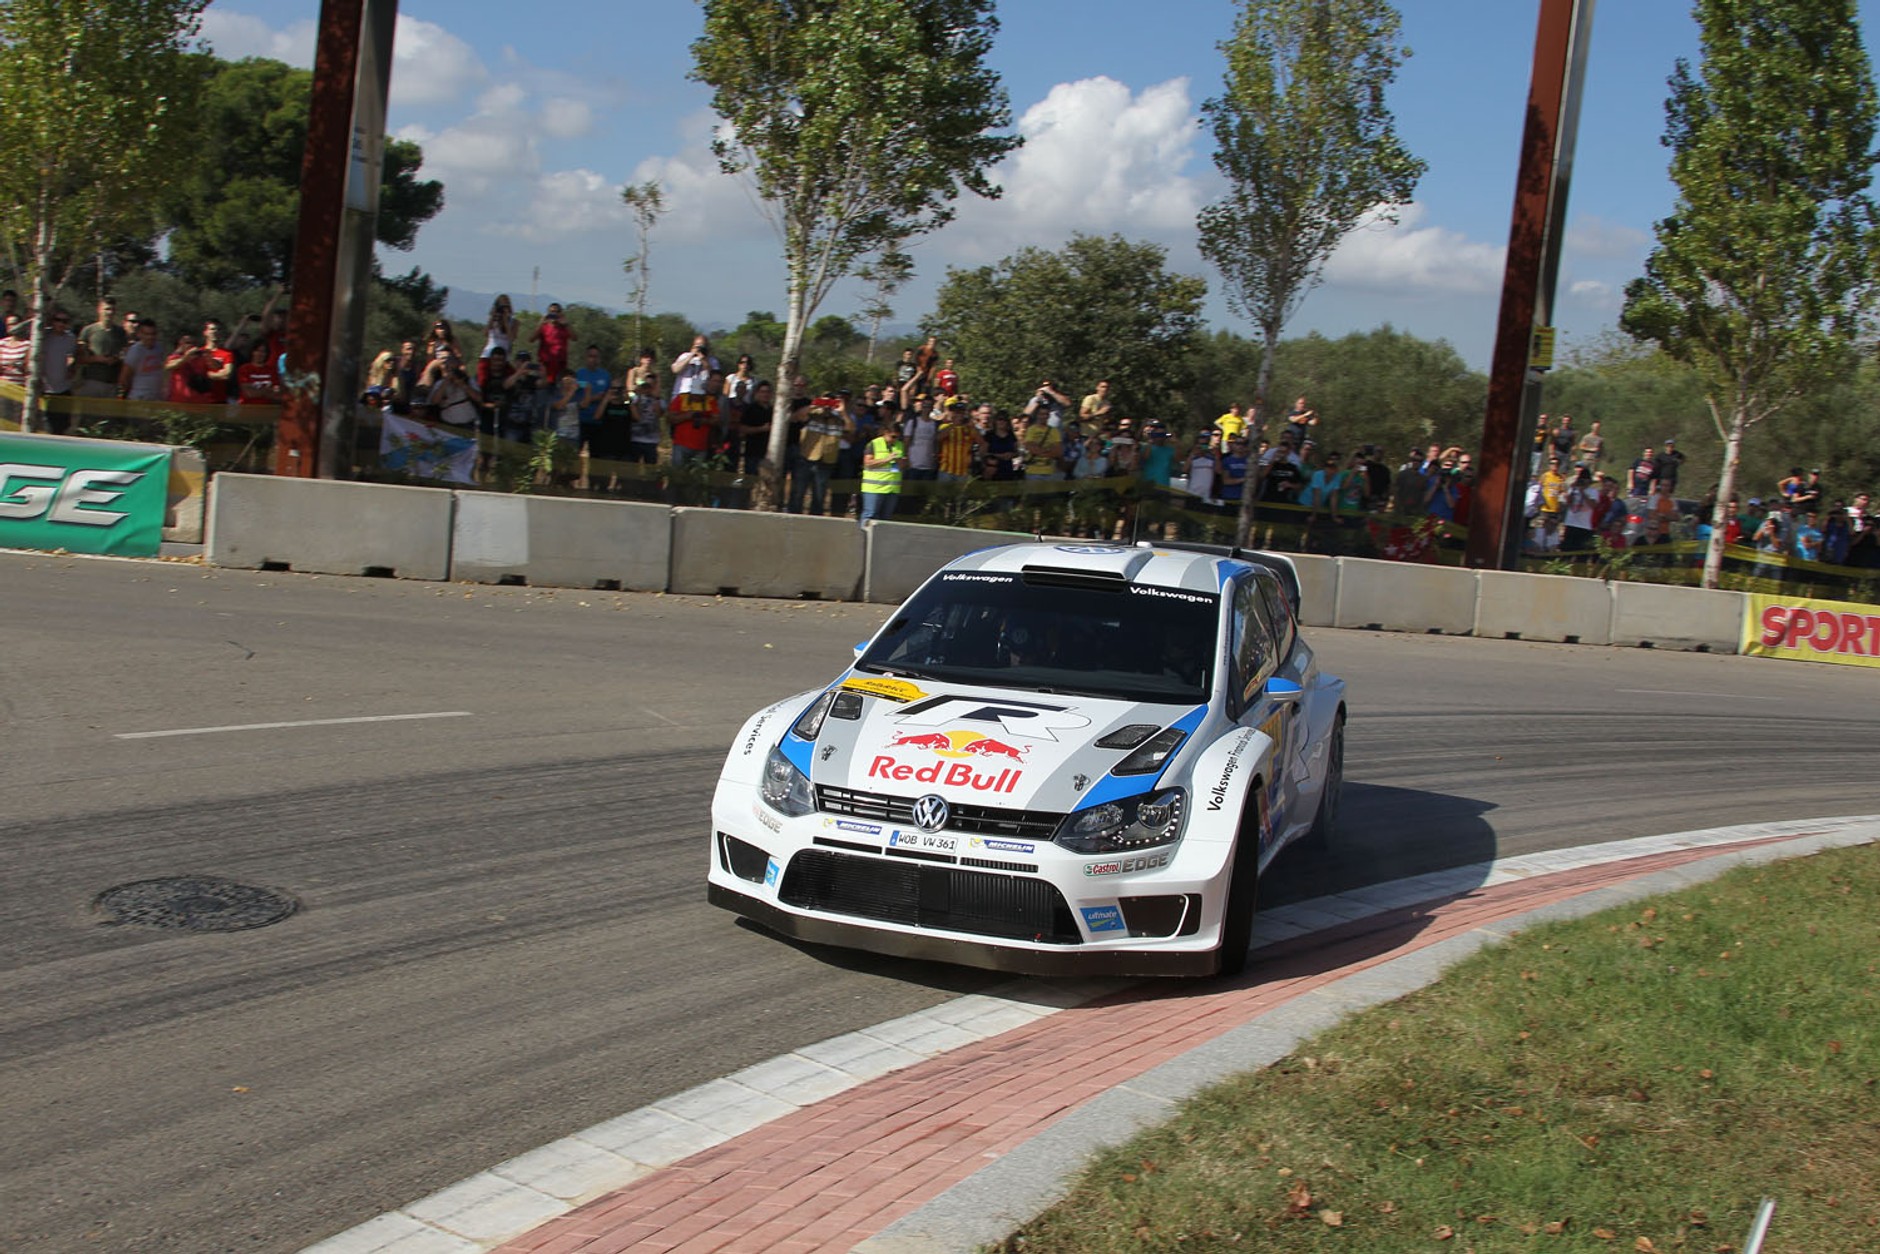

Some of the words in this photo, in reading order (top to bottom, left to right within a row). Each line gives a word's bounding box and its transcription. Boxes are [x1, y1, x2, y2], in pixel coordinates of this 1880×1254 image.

[943, 573, 1013, 583] Volkswagen
[1130, 586, 1213, 604] Volkswagen
[744, 714, 772, 755] Services
[868, 755, 945, 783] Red
[944, 763, 1023, 793] Bull
[1207, 757, 1239, 811] Volkswagen
[839, 821, 881, 834] MICHELIN
[898, 833, 918, 845] WOB
[923, 836, 936, 847] VW
[936, 838, 956, 850] 361
[988, 840, 1034, 852] MICHELIN
[1092, 862, 1120, 875] Castrol
[1122, 852, 1169, 873] EDGE
[1088, 910, 1118, 920] ultimate
